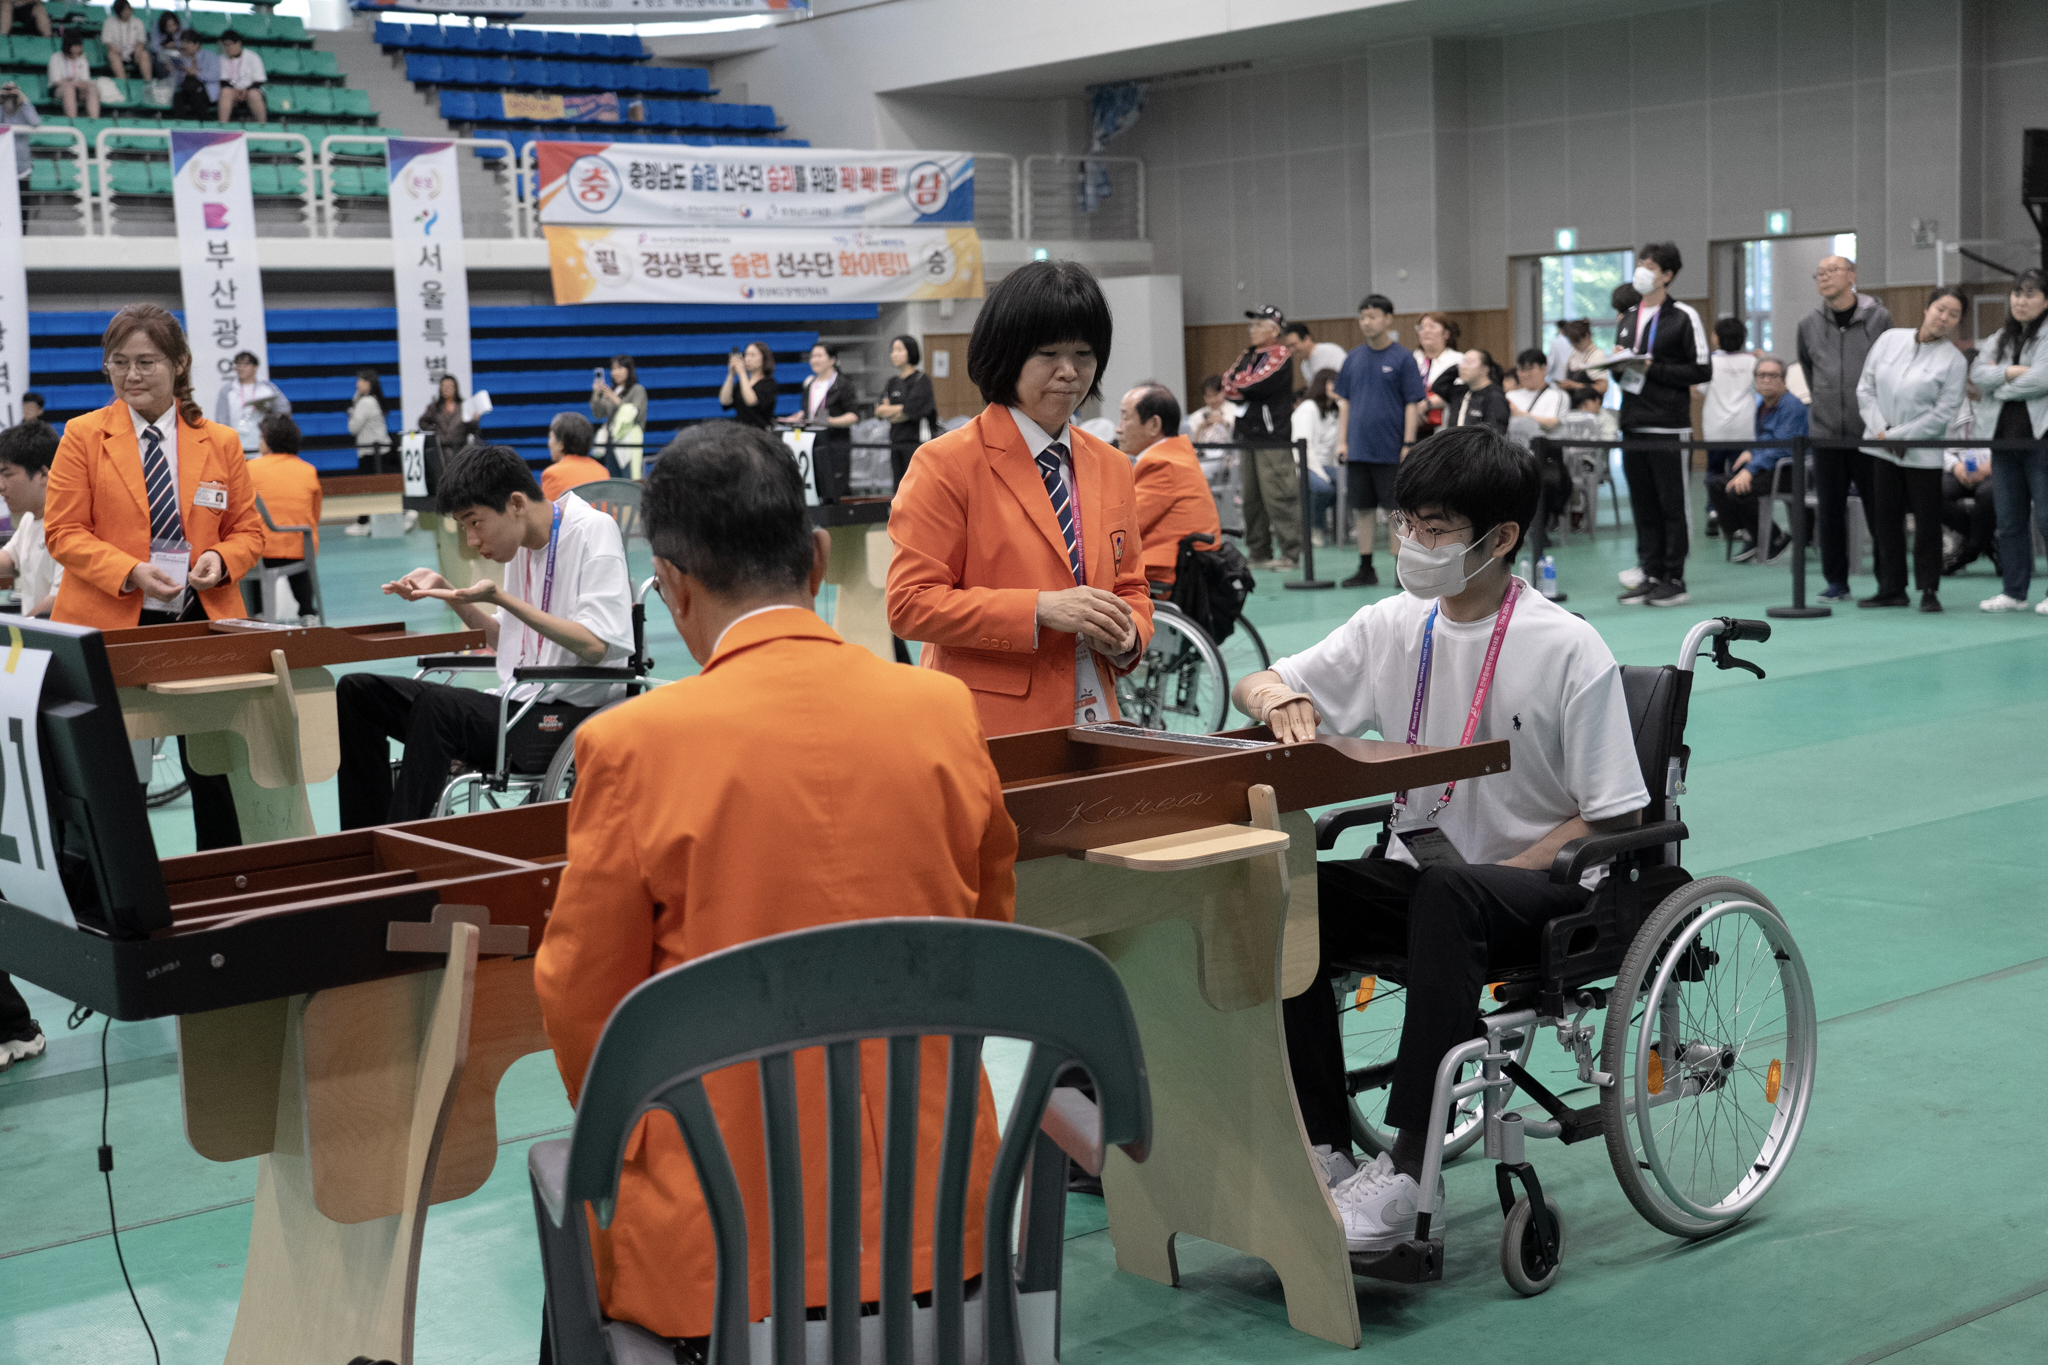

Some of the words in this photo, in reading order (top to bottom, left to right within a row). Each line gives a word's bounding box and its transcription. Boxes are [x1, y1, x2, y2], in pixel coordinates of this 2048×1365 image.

[578, 166, 610, 203] 충
[629, 160, 687, 191] 충청남도
[690, 163, 718, 192] 슐런
[723, 163, 764, 193] 선수단
[766, 165, 807, 194] 승리를
[810, 165, 837, 194] 위한
[915, 172, 942, 206] 남
[592, 248, 622, 277] 필
[640, 251, 728, 279] 경상북도
[730, 252, 771, 278] 슐런
[776, 251, 834, 278] 선수단
[927, 249, 947, 277] 승
[404, 451, 425, 483] 23
[1498, 615, 1506, 626] The
[1501, 603, 1511, 617] 20th
[1421, 647, 1430, 662] 20th
[1418, 662, 1427, 682] Korean
[1416, 682, 1424, 698] Youth
[1414, 697, 1422, 711] Para
[1411, 710, 1420, 730] Games
[1465, 718, 1475, 738] Games
[1042, 792, 1213, 835] Korea
